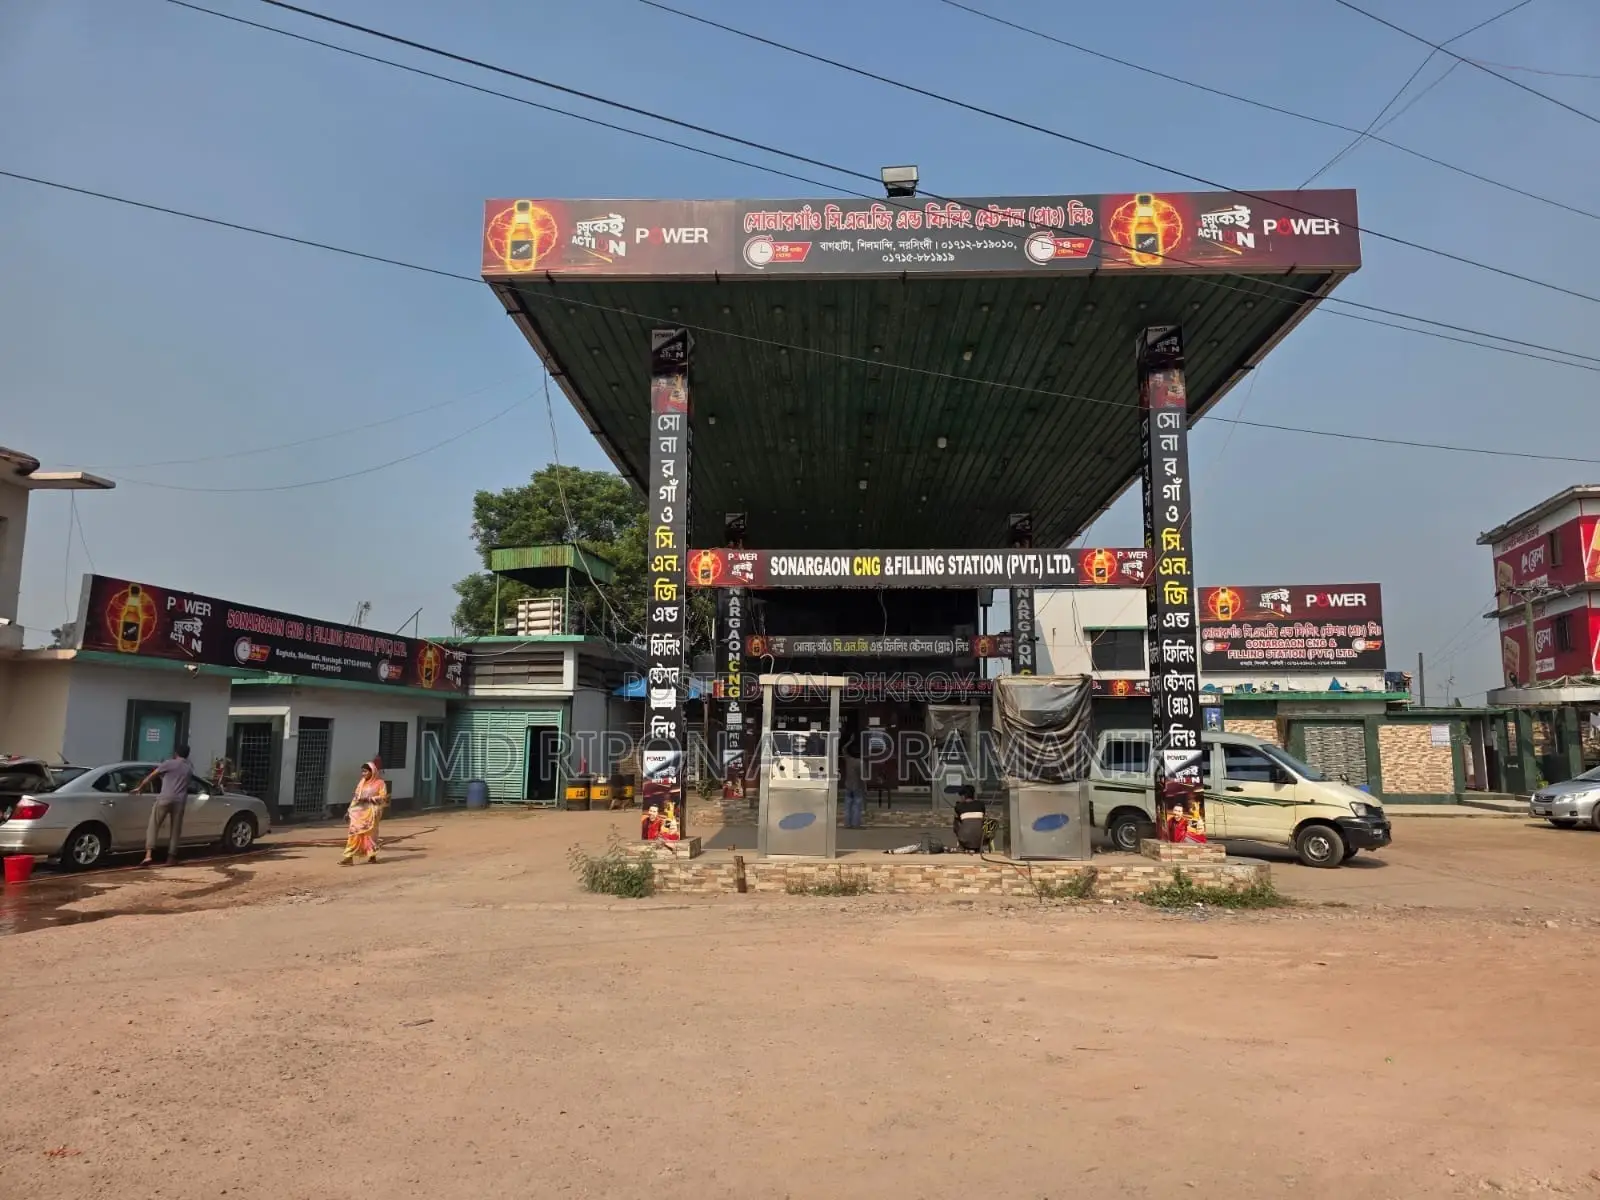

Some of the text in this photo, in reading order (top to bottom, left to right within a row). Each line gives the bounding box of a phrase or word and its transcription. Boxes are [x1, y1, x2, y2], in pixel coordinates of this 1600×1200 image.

[576, 213, 626, 237] চুমুকেই
[743, 204, 822, 233] সোনারগাঁও
[825, 203, 893, 231] সি.এন.জি
[925, 202, 973, 228] ফিলিং
[1067, 200, 1093, 226] লিঃ
[1201, 205, 1251, 229] চুমুকেই
[1263, 217, 1340, 235] POWER
[635, 227, 708, 244] POWER
[770, 556, 850, 576] SONARGAON
[853, 556, 880, 576] CNG
[948, 555, 1003, 575] STATION
[1007, 554, 1043, 579] (PVT.)
[1046, 554, 1075, 575] LTD.
[1117, 551, 1148, 559] POWER
[166, 596, 212, 617] POWER
[1306, 592, 1367, 607] POWER
[227, 608, 284, 637] SONARGAON
[313, 625, 343, 647] FILLING
[650, 633, 680, 657] ফিলিং
[1163, 639, 1194, 663] ফিলিং
[1228, 650, 1263, 659] FILLING
[1265, 649, 1306, 659] STATION
[1336, 649, 1358, 658] LTD.
[1246, 639, 1337, 649] SONARGAON CNG &
[728, 701, 740, 712] &
[1167, 694, 1193, 718] (প্রাঃ)
[650, 716, 676, 739] লিঃ
[1169, 723, 1196, 747] লিঃ
